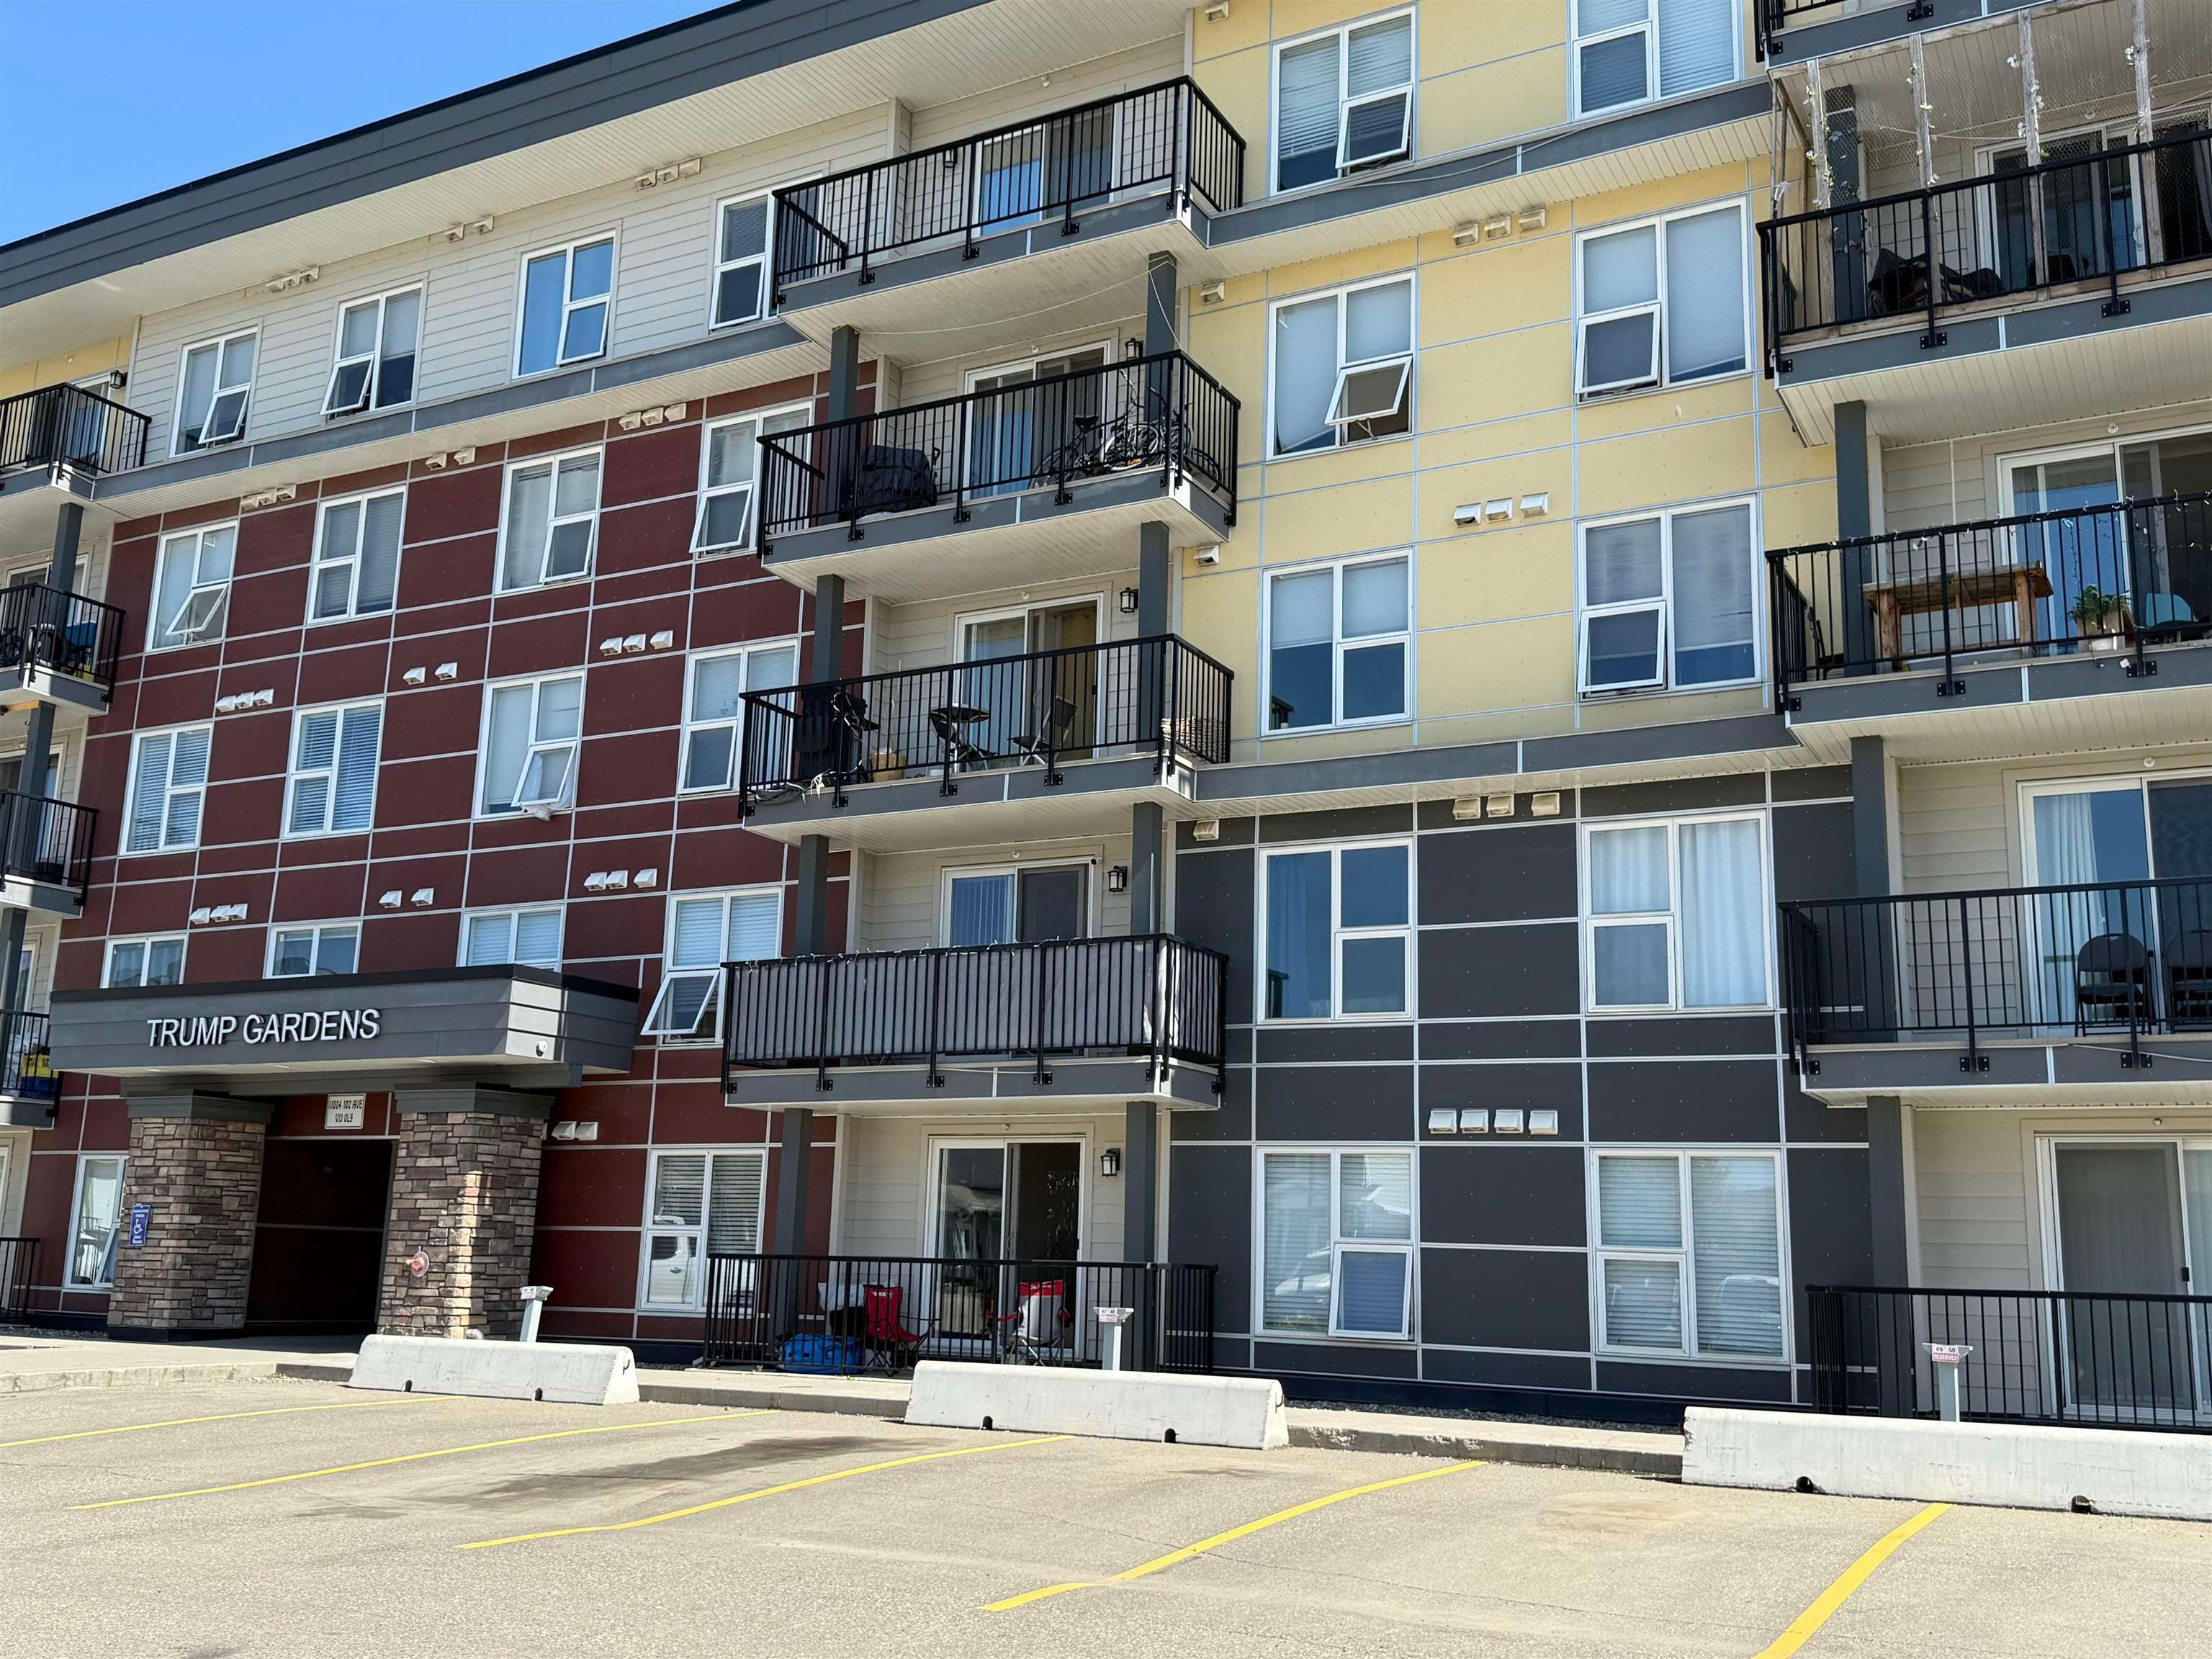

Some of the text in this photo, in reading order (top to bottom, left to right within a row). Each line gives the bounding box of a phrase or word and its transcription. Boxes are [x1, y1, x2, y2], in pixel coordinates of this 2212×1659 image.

[147, 1008, 380, 1047] TRUMP GARDENS
[352, 1099, 363, 1109] AVE
